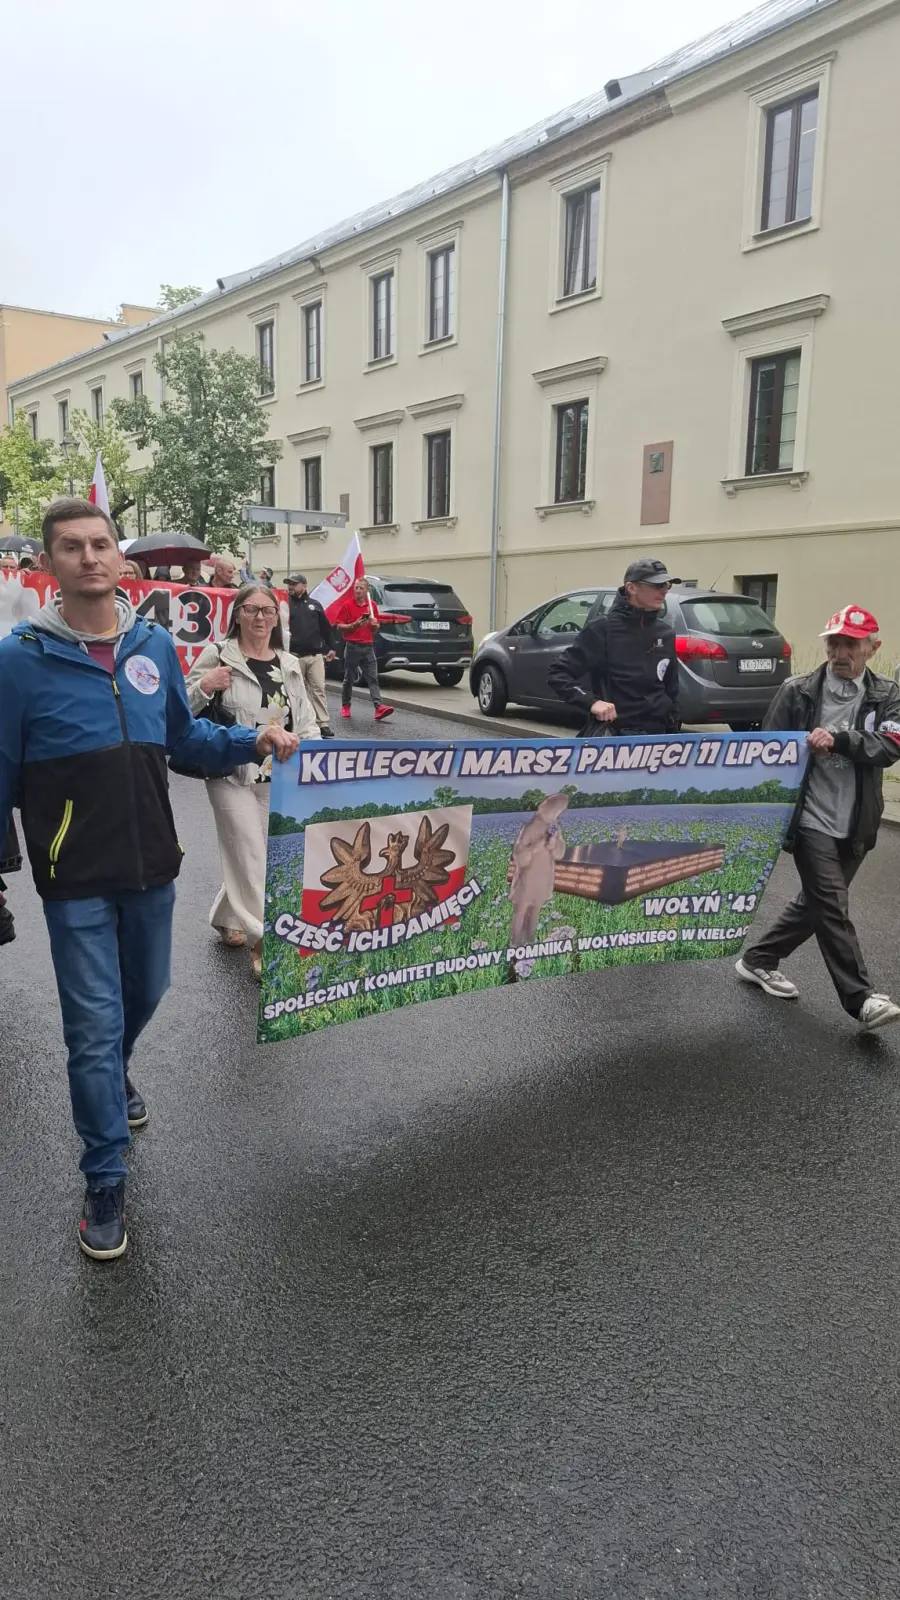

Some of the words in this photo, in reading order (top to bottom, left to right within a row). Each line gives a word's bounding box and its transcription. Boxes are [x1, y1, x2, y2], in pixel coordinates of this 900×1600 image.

[299, 750, 455, 783] KIELECKI
[460, 748, 572, 775] MARSZ
[577, 741, 691, 772] PAMIĘCI
[698, 741, 718, 765] 11
[723, 741, 798, 765] LIPCA
[274, 913, 344, 951] CZEŚĆ
[347, 928, 390, 952] ICH
[391, 879, 482, 943] PAMIĘCI
[644, 890, 721, 916] WOŁYŃ
[727, 894, 757, 913] '43
[263, 979, 360, 1020] SPOŁECZNY
[364, 962, 435, 992] KOMITET
[434, 950, 503, 976] BUDOWY
[506, 939, 573, 962] POMNIKA
[577, 929, 678, 951] WOŁYŃSKIEGO
[681, 928, 696, 941] W
